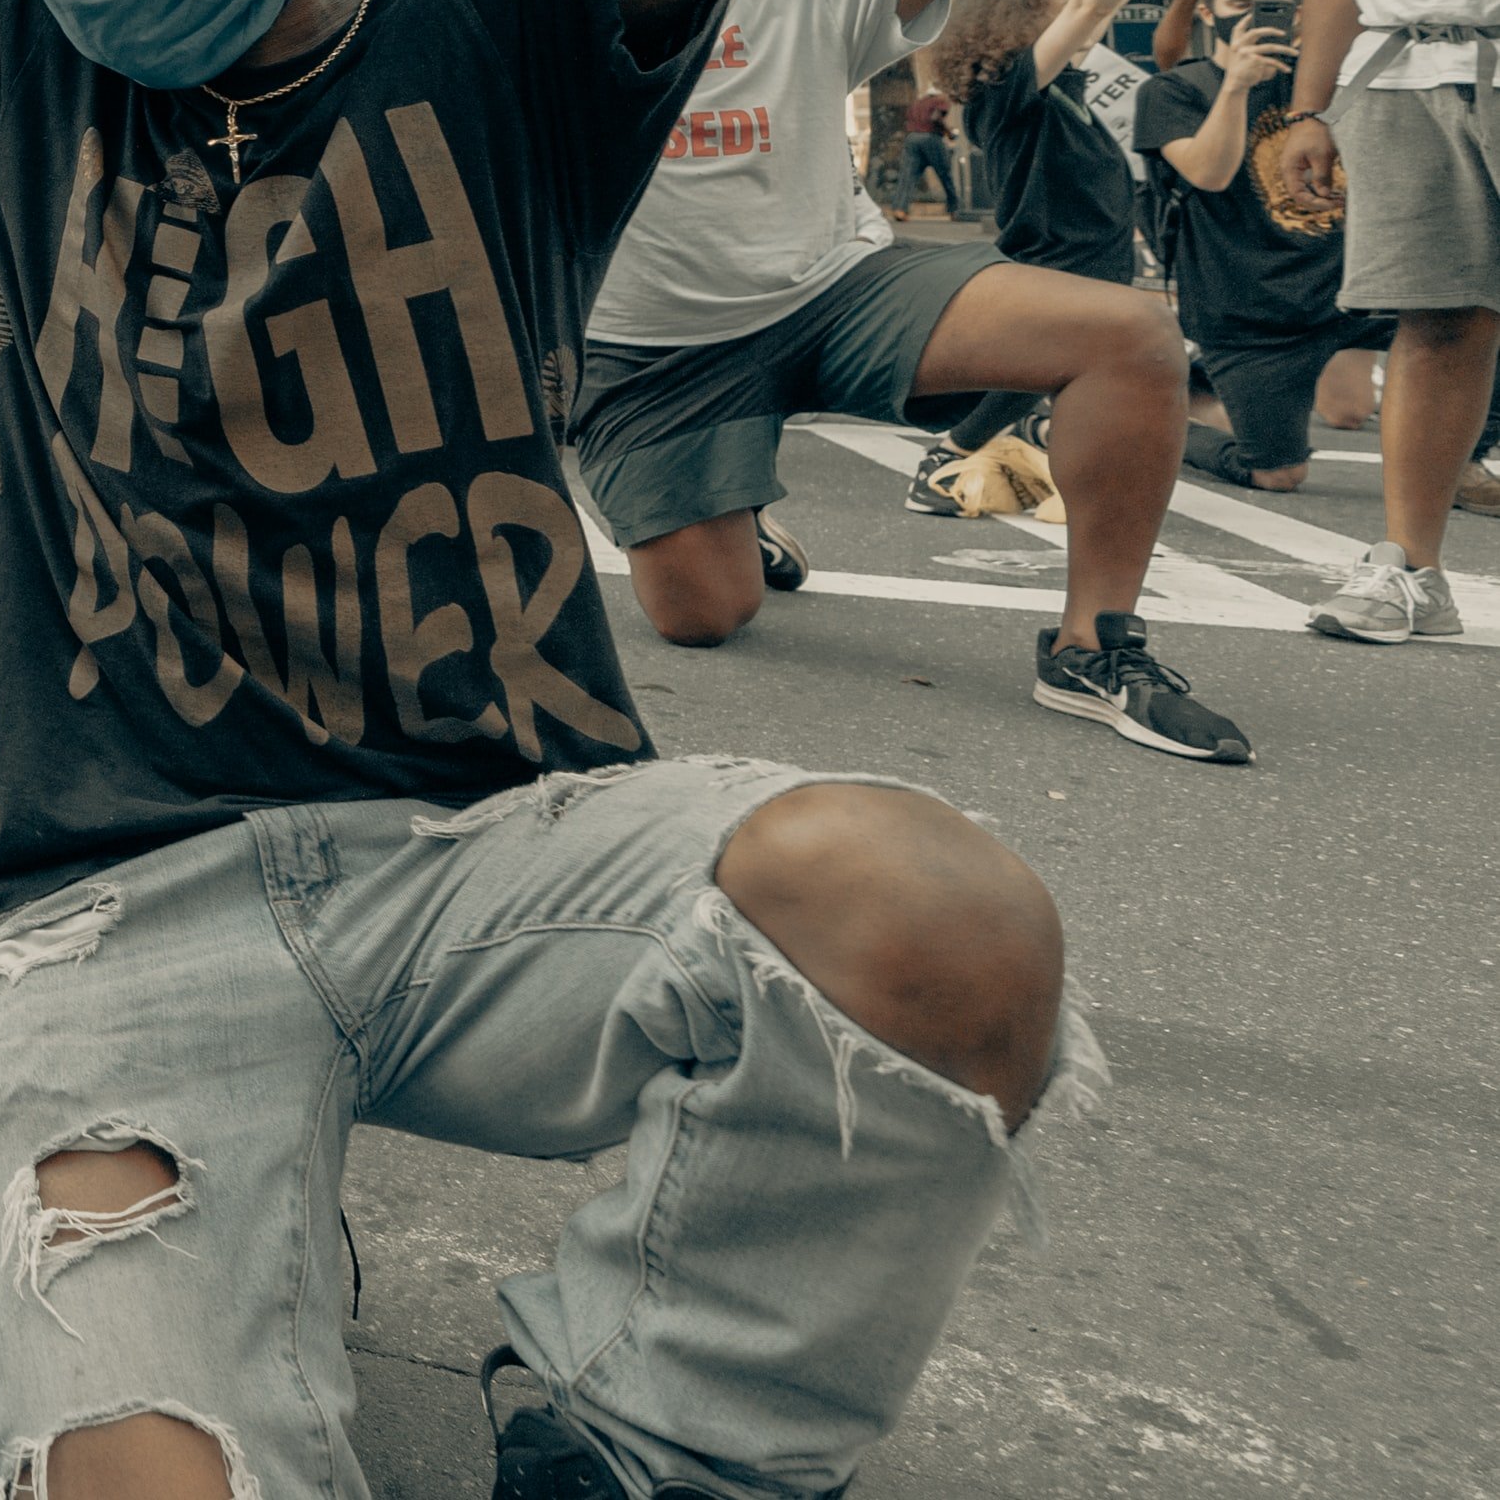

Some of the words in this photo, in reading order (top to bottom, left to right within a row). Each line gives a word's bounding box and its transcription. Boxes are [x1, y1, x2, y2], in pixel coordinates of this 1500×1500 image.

[1090, 73, 1139, 109] TER
[661, 107, 771, 159] SED!
[52, 431, 643, 763] POWER
